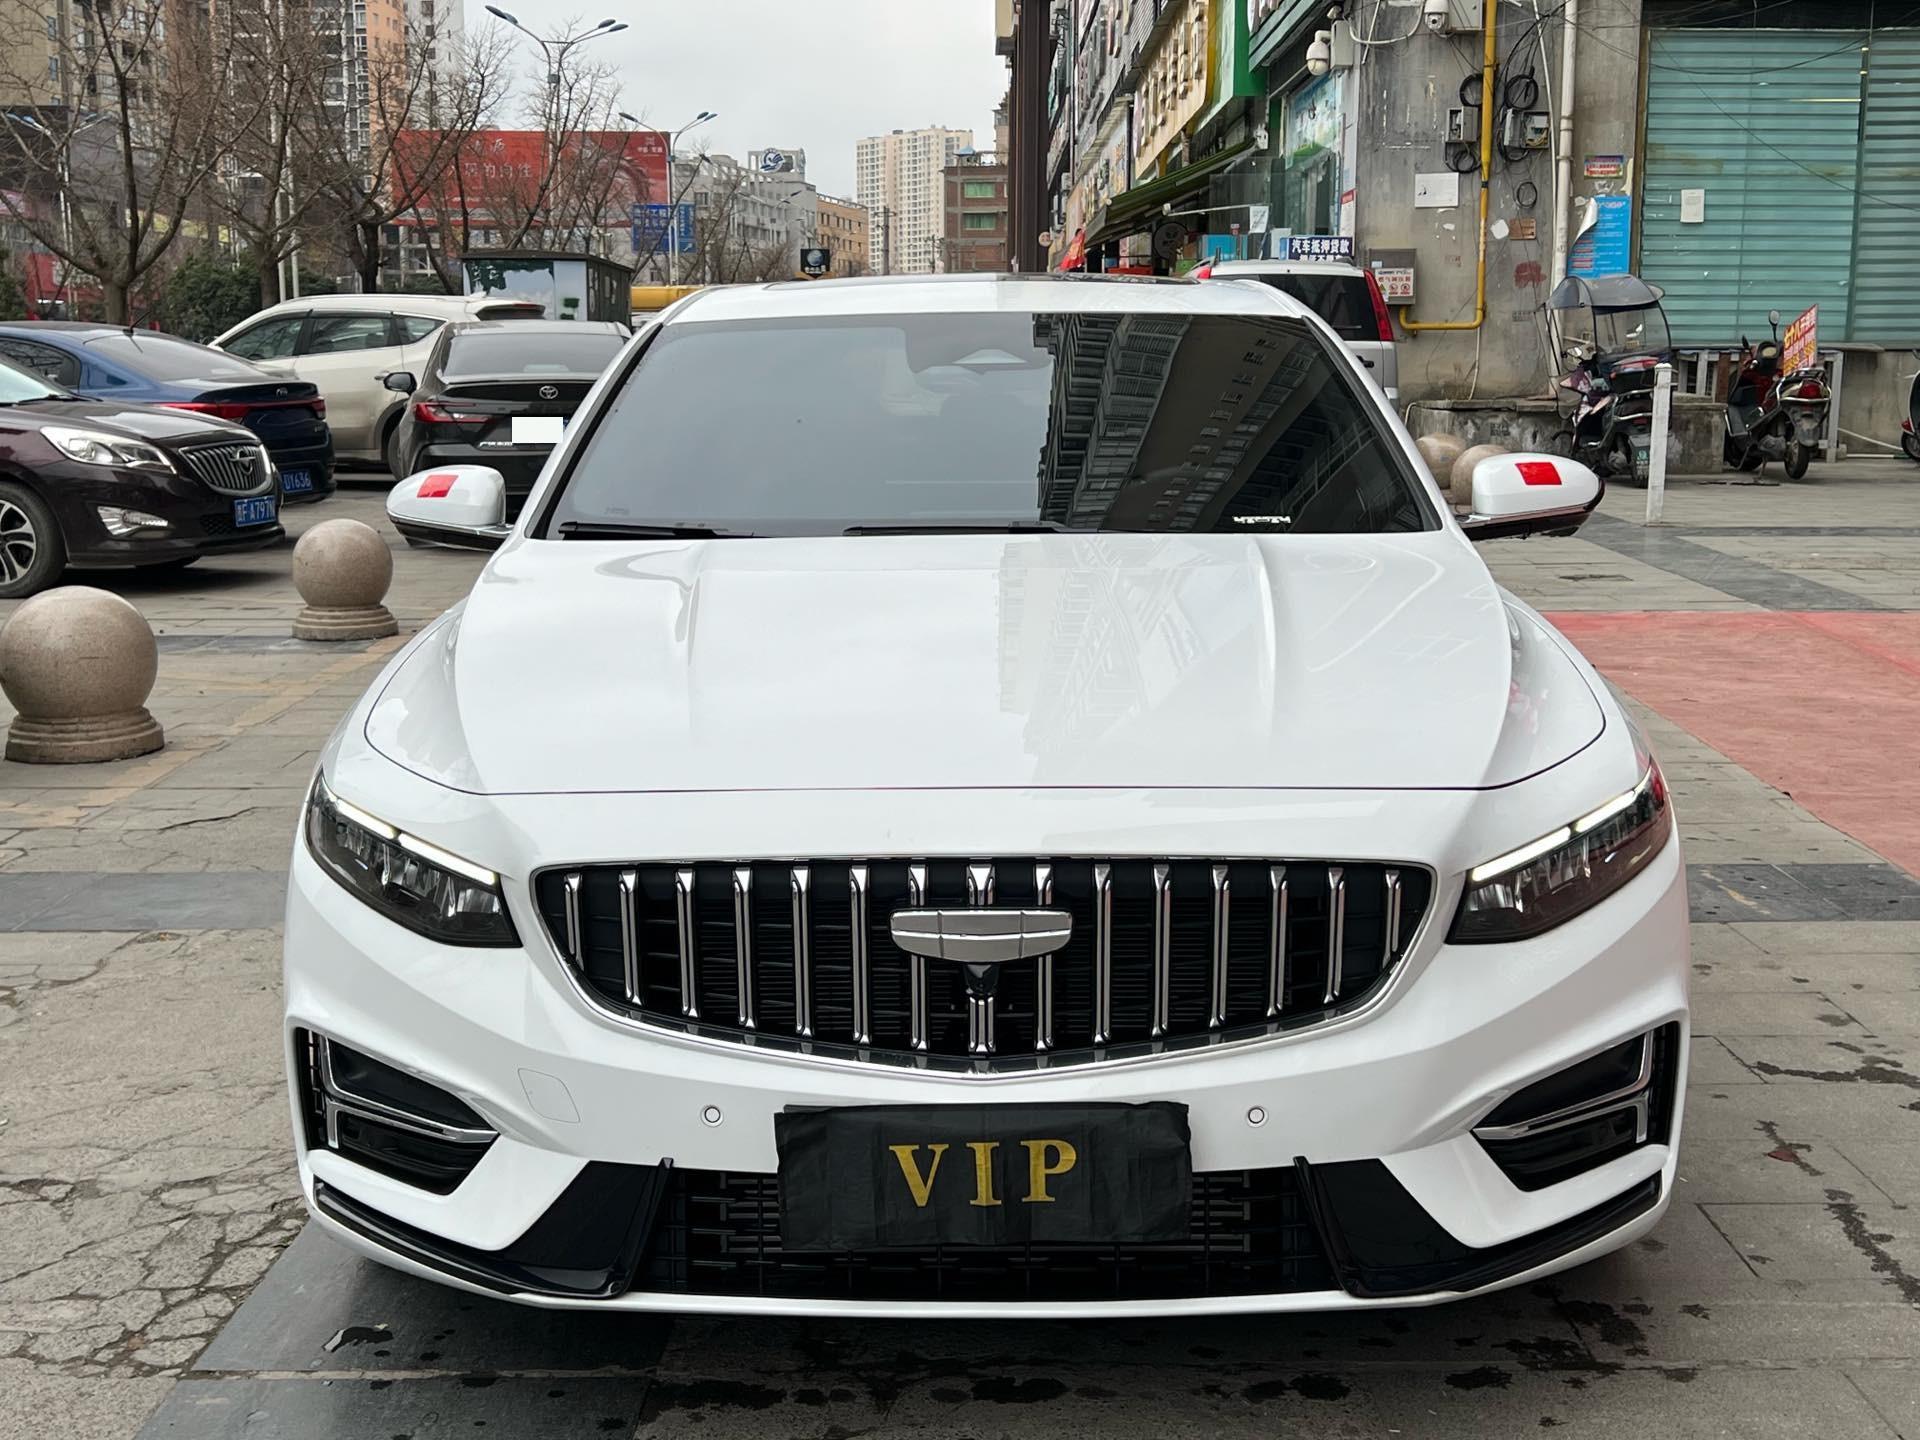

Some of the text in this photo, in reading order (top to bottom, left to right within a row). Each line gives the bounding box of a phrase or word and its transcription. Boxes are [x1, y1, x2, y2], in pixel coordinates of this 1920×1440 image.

[1292, 239, 1349, 253] 汽车抵押贷款
[888, 1138, 1078, 1208] VIP
